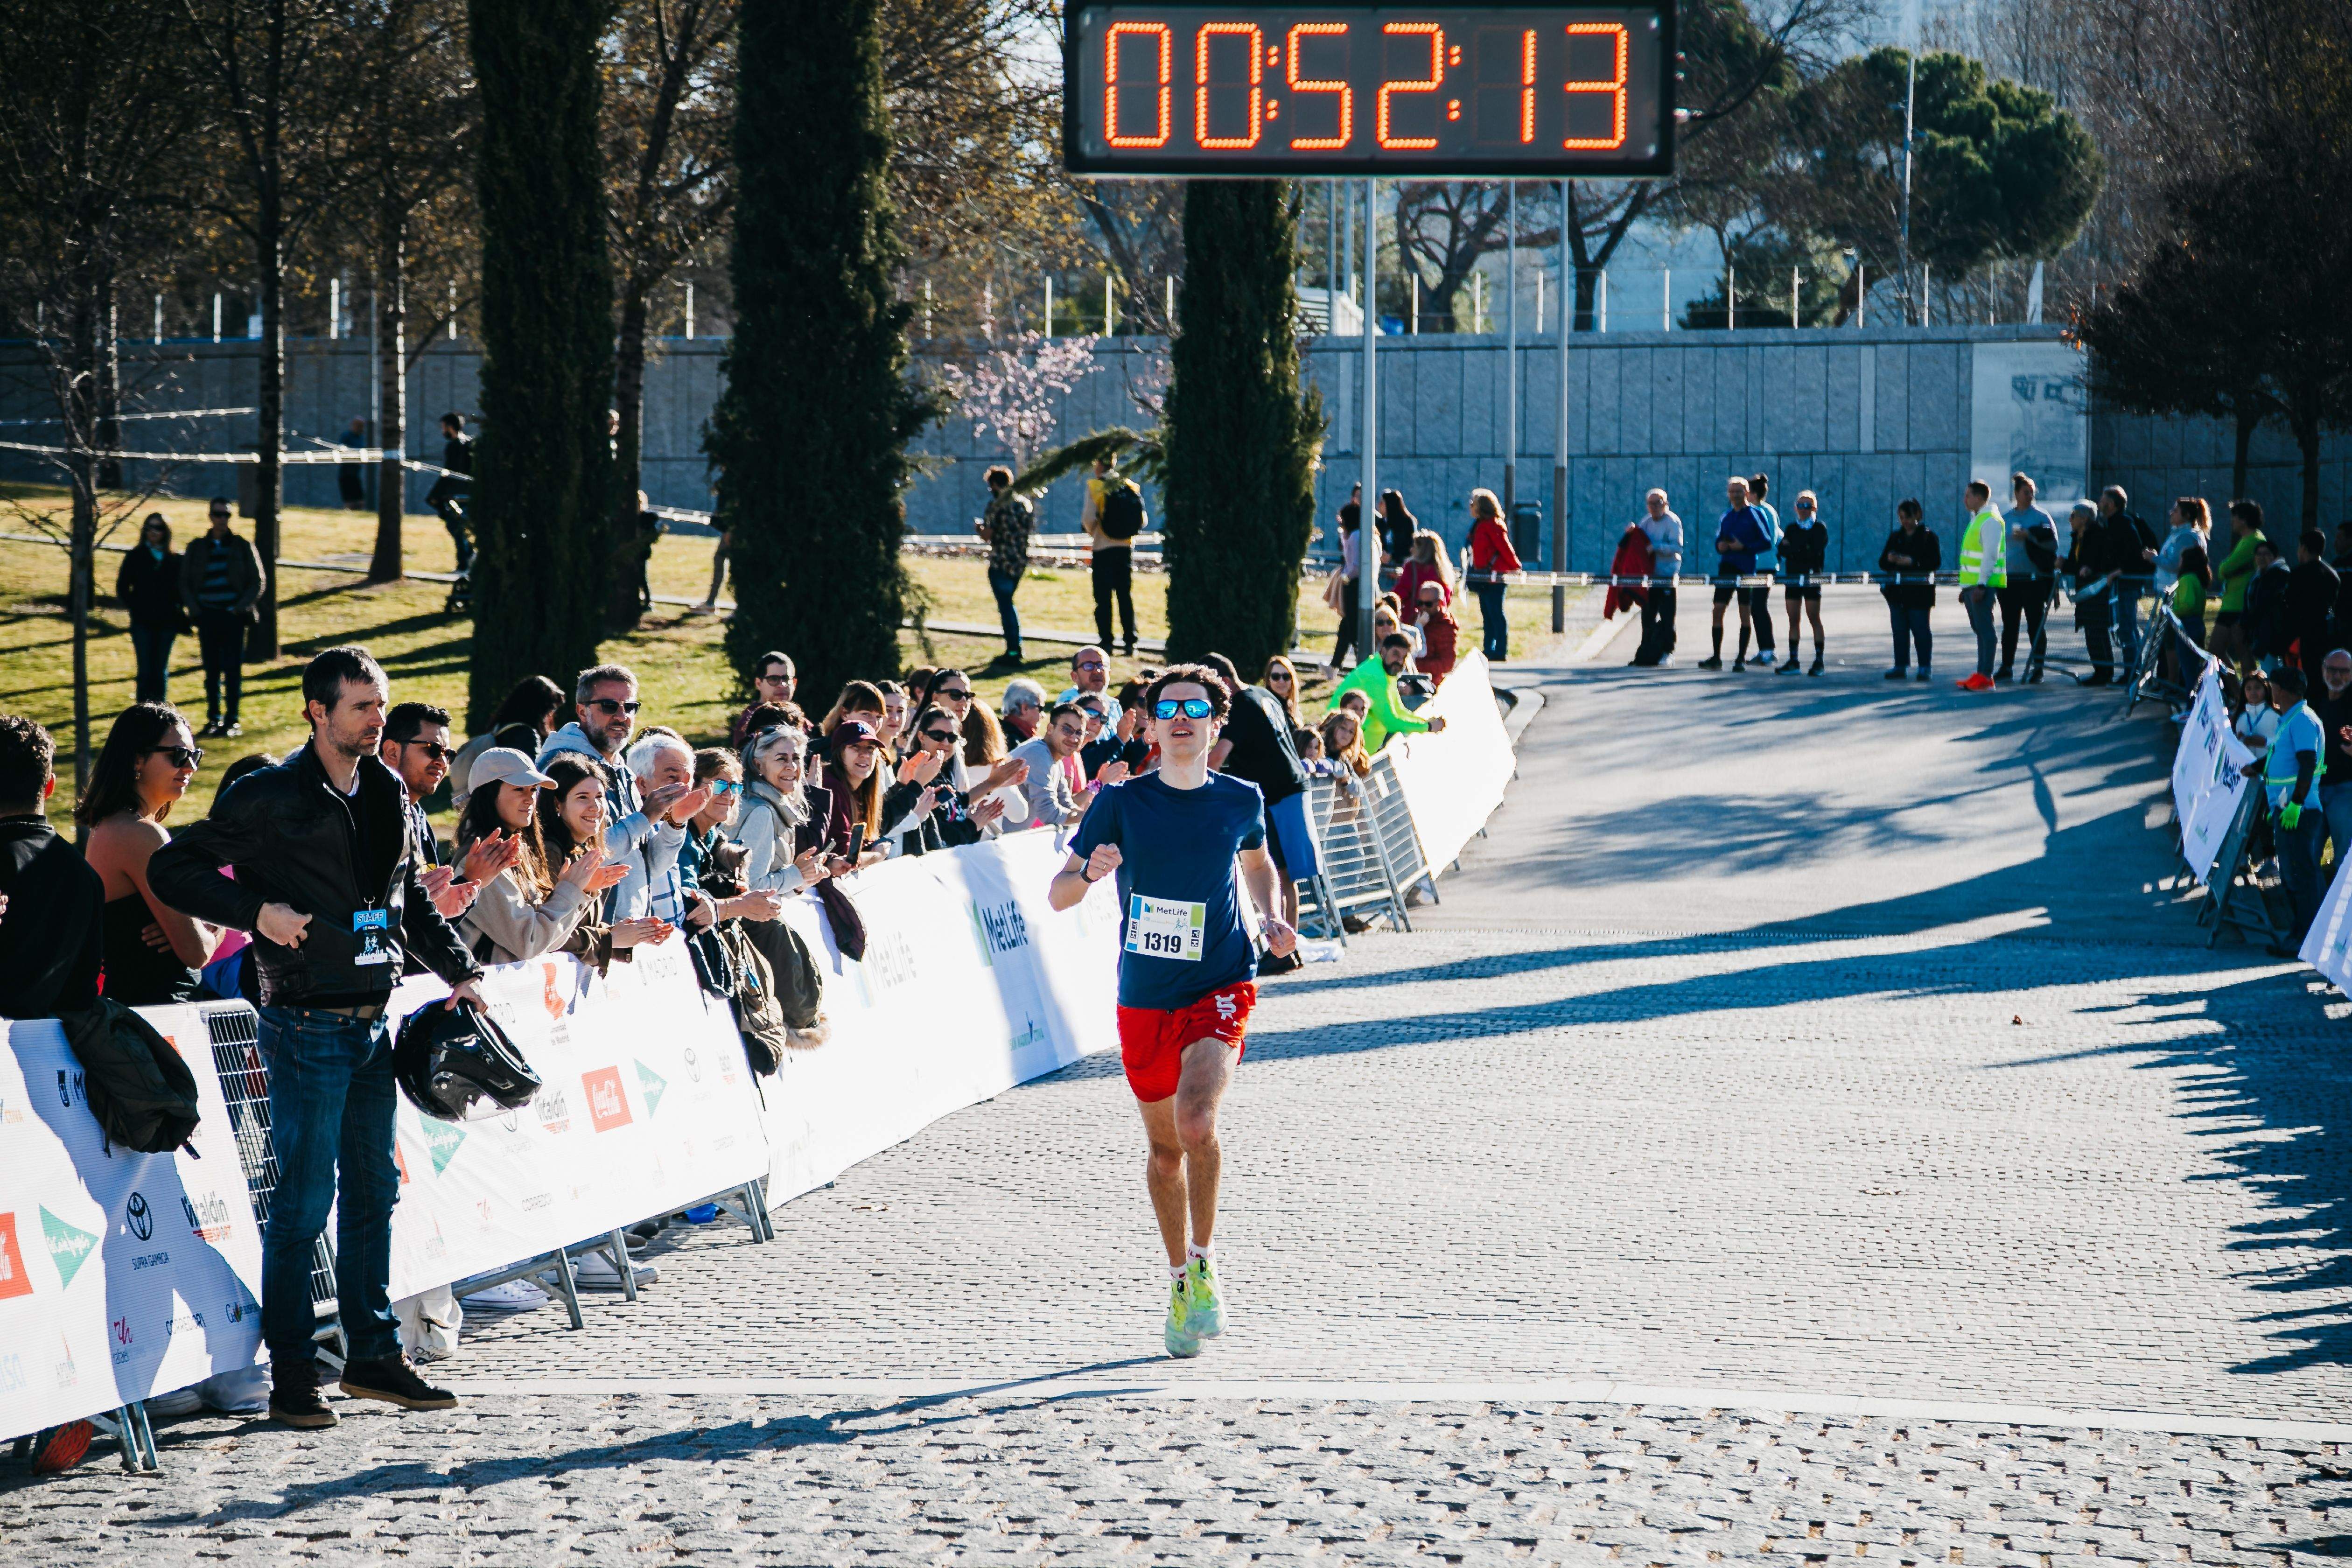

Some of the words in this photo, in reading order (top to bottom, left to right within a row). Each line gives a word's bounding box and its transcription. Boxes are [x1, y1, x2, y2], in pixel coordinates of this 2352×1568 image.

[1105, 22, 1627, 149] 00:52:13
[357, 912, 383, 923] STAFF
[982, 901, 1028, 953] MetLife
[1156, 906, 1188, 916] MetLife
[1144, 932, 1182, 953] 1319
[867, 931, 917, 991] MetLife
